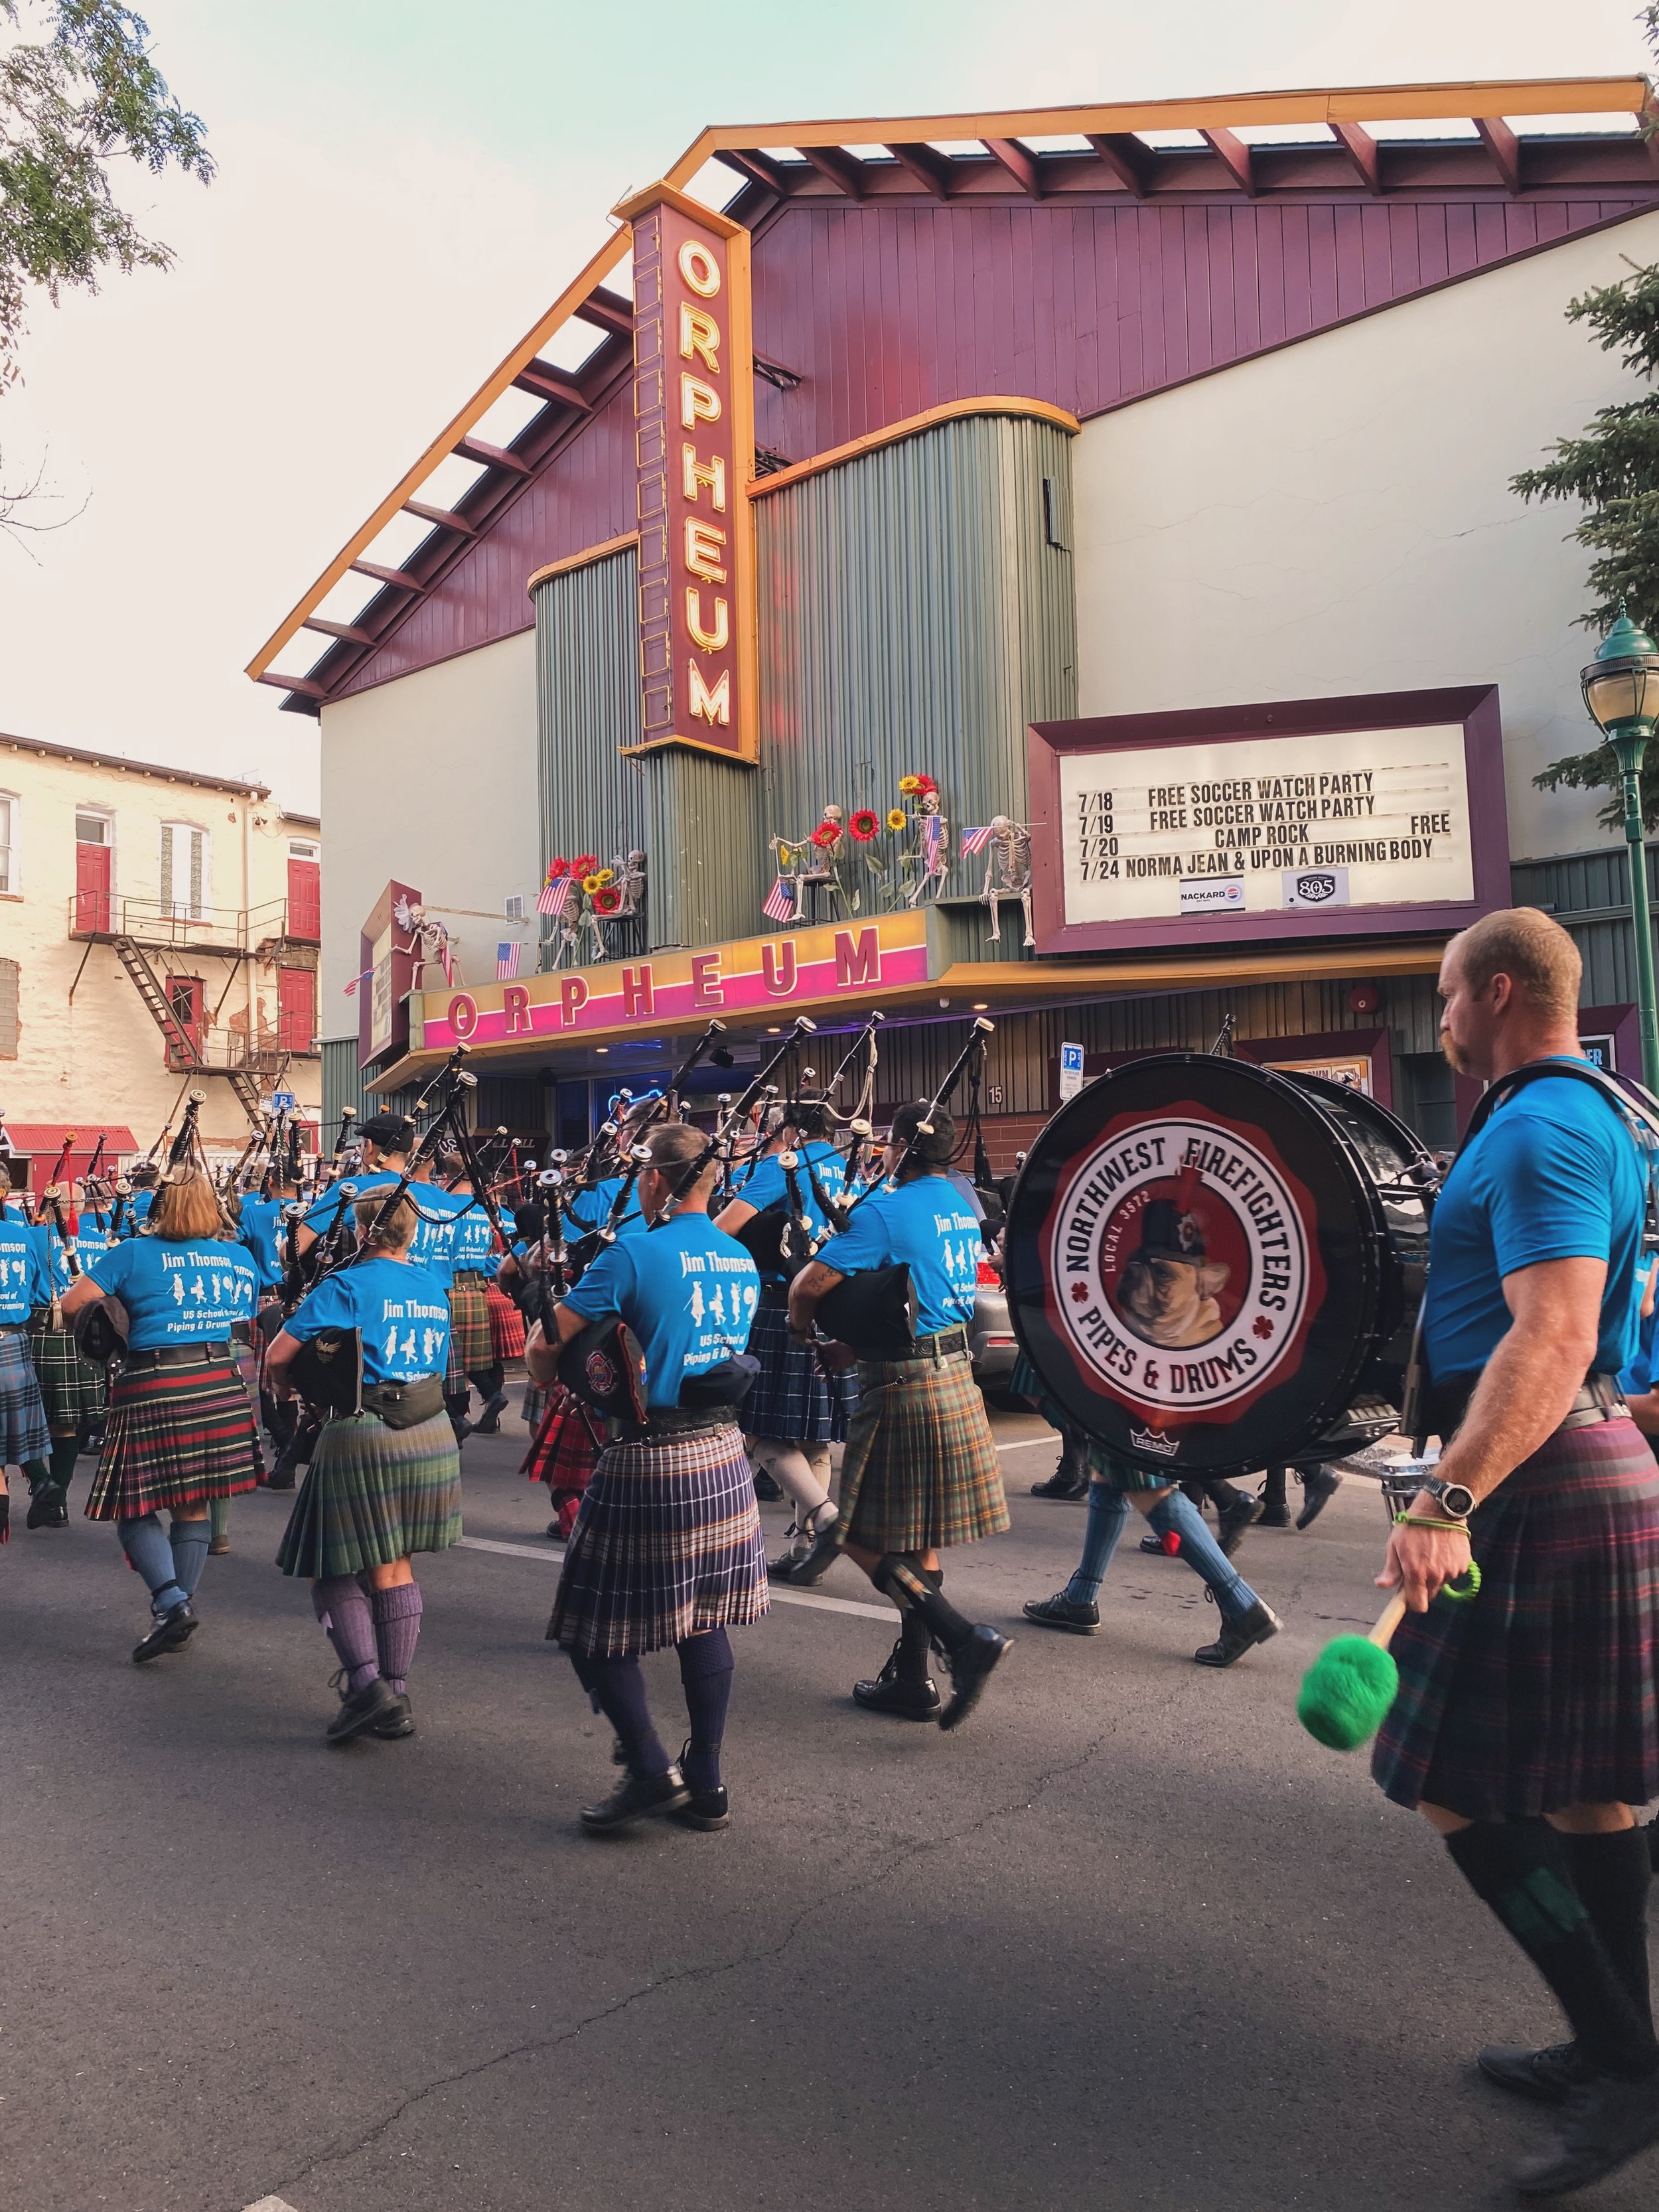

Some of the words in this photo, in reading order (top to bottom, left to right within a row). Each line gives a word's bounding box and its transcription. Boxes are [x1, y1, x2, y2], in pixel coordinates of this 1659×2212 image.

[678, 239, 731, 727] ORPHEUM
[1079, 791, 1113, 812] 7/18
[1149, 786, 1186, 807] FREE
[1190, 781, 1252, 804] SOCCER
[1258, 776, 1315, 799] WATCH
[1320, 772, 1373, 795] PARTY
[1079, 814, 1113, 835] 7/19
[1151, 809, 1187, 830] FREE
[1193, 804, 1254, 827] SOCCER
[1260, 800, 1317, 822] WATCH
[1321, 796, 1375, 818] PARTY
[1080, 837, 1119, 857] 7/20
[1215, 827, 1261, 848] CAMP
[1267, 824, 1309, 844] ROCK
[1411, 814, 1451, 834] FREE
[1081, 860, 1119, 880] 7/24
[1126, 856, 1183, 877] NORMA
[1187, 853, 1228, 873] JEAN
[1234, 851, 1246, 870] &
[1251, 848, 1293, 869] UPON
[1299, 847, 1309, 865] A
[1314, 841, 1386, 864] BURNING
[1390, 838, 1433, 860] BODY
[1181, 891, 1225, 901] NACKARD
[1299, 879, 1334, 895] 805
[447, 925, 882, 1039] ORPHEUM
[1069, 1051, 1076, 1066] P
[1582, 1048, 1603, 1065] ER
[989, 1086, 1002, 1103] 15
[818, 1163, 833, 1179] Jim
[1066, 1137, 1166, 1272] NORTHWEST
[933, 1213, 952, 1238] Jim
[1184, 1137, 1292, 1312] FIREFIGHTERS
[0, 1242, 26, 1253] mson
[1104, 1225, 1123, 1272] LOCAL
[162, 1252, 186, 1272] Jim
[187, 1251, 232, 1268] Thomson
[679, 1250, 706, 1278] Jim
[183, 1310, 195, 1319] US
[196, 1309, 224, 1319] School
[382, 1298, 403, 1323] Jim
[167, 1322, 195, 1333] Piping
[197, 1321, 204, 1330] &
[699, 1333, 713, 1347] US
[1078, 1306, 1137, 1376] PIPES
[1143, 1359, 1159, 1390] &
[1169, 1338, 1258, 1394] DRUMS
[684, 1350, 711, 1366] Piping
[712, 1347, 719, 1360] &
[1135, 1437, 1173, 1453] REMO
